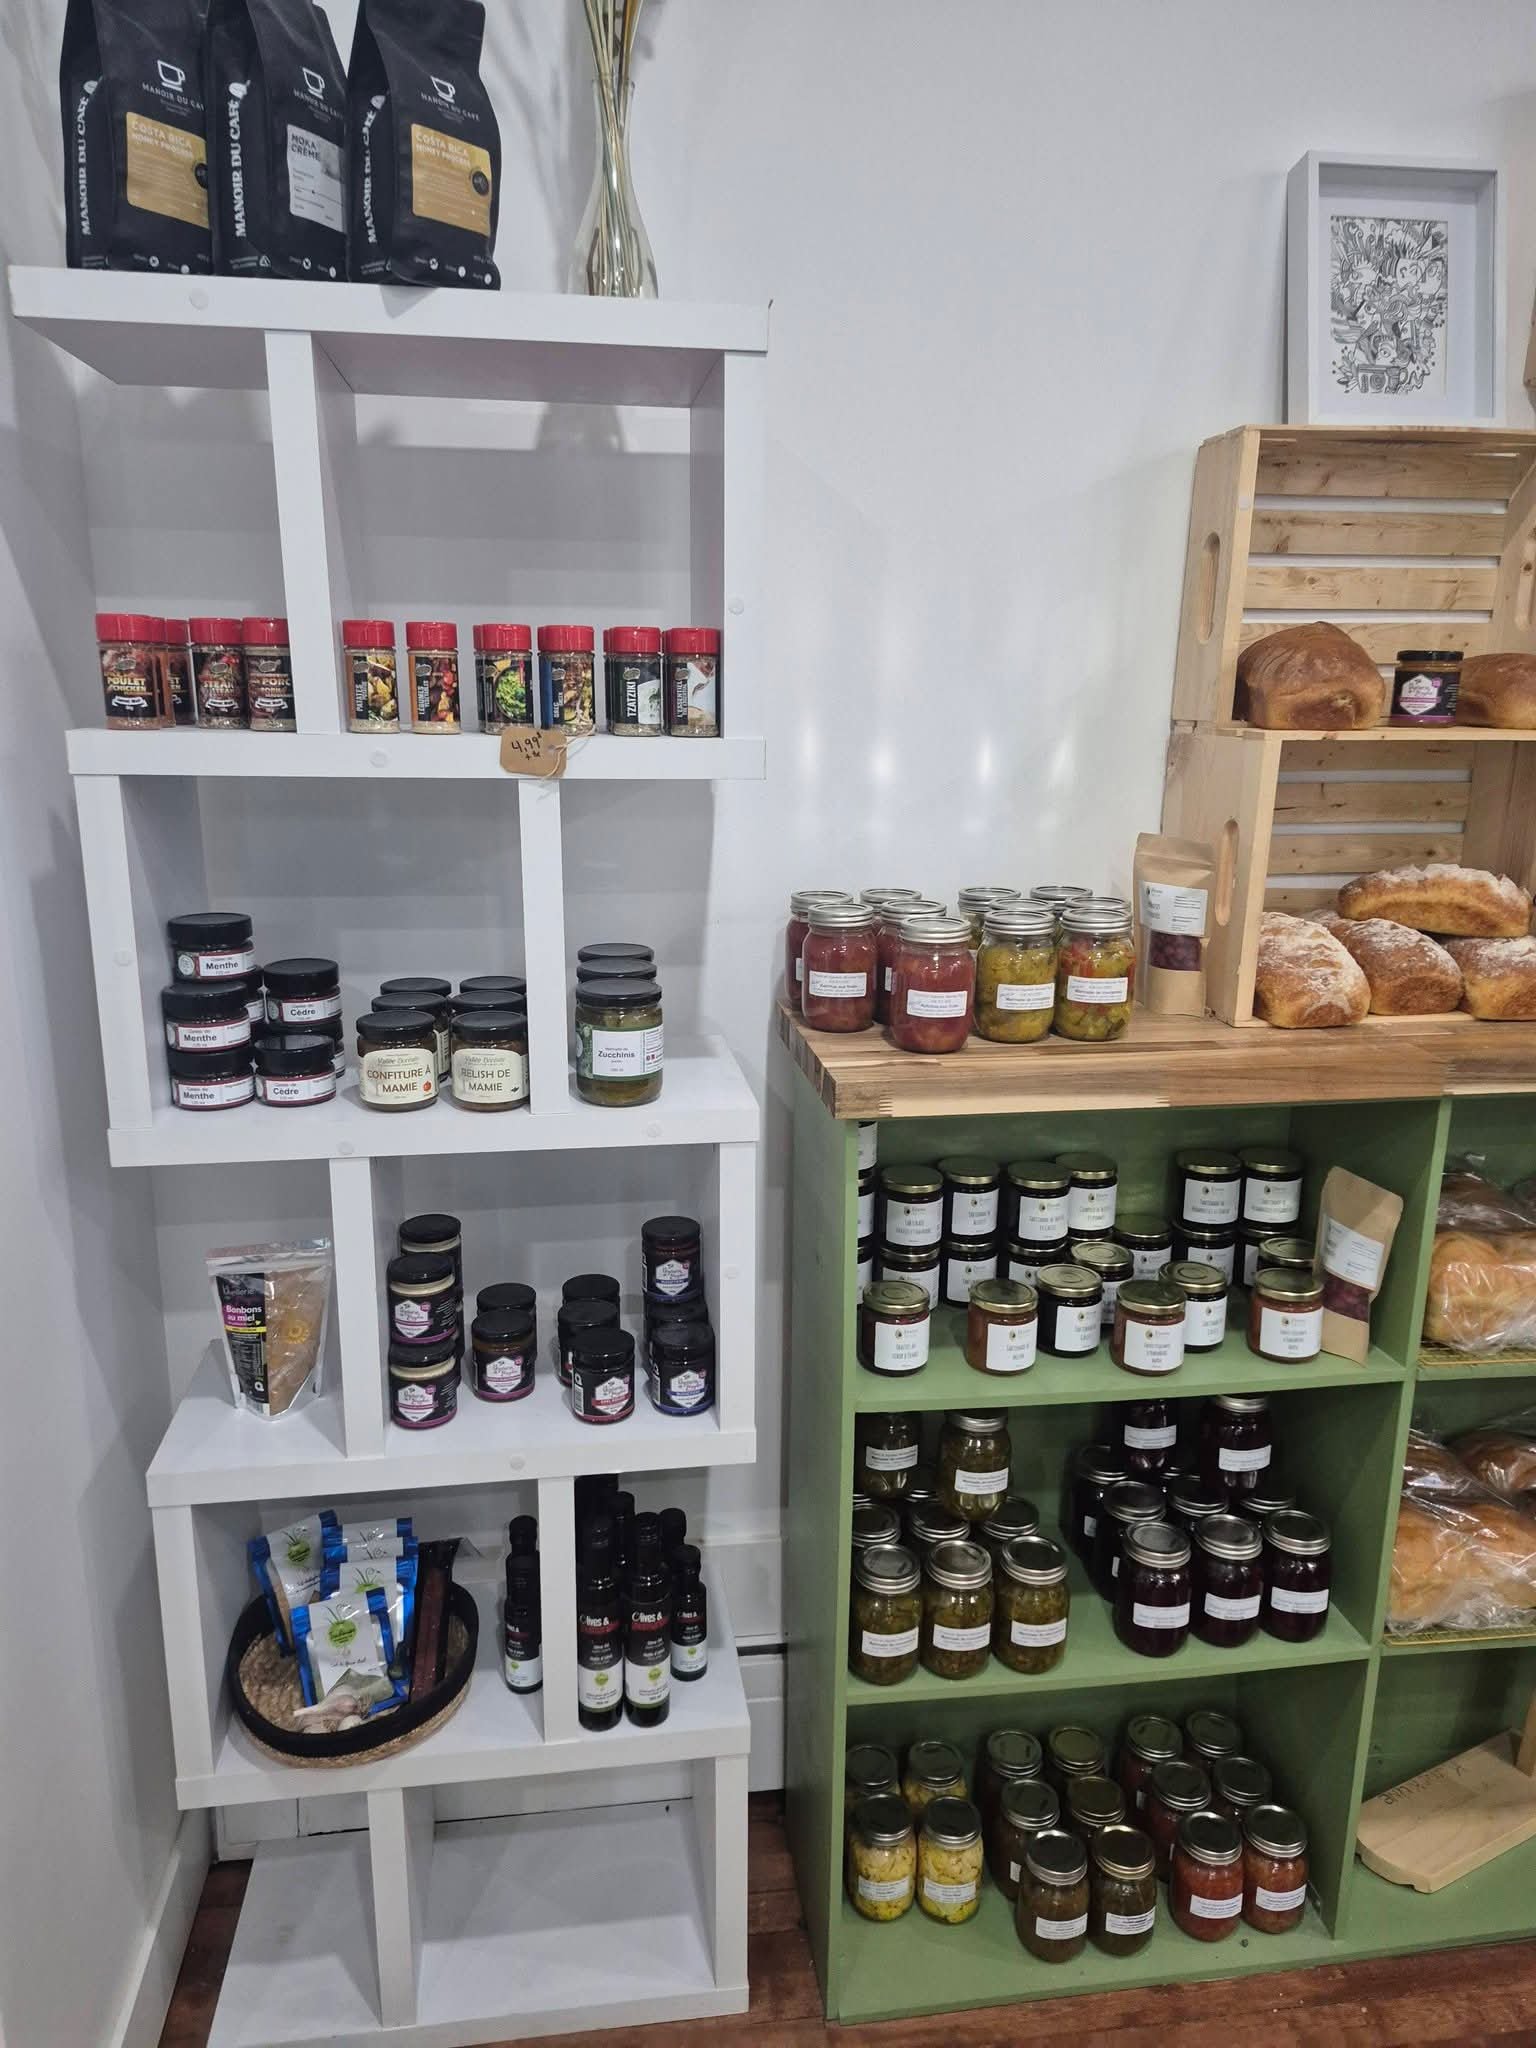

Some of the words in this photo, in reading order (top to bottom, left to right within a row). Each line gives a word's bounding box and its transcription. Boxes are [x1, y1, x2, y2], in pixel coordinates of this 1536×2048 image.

[142, 82, 175, 100] MANOIR
[177, 95, 188, 105] DU
[291, 132, 317, 151] MOKA
[78, 139, 86, 163] DU
[230, 142, 242, 167] DU
[79, 168, 91, 235] MANOIR
[231, 170, 247, 237] MANOIR
[106, 677, 146, 686] POULET
[626, 681, 637, 717] TZATZIKI
[206, 962, 239, 970] Menthe
[184, 1034, 217, 1042] Menthe
[598, 1050, 635, 1058] Zucchinis
[367, 1068, 423, 1080] CONFITURE
[461, 1068, 494, 1079] RELISH
[497, 1068, 511, 1078] DE
[382, 1082, 418, 1093] MAMIE
[468, 1082, 503, 1092] MAMIE
[183, 1091, 215, 1100] Menthe
[226, 1304, 262, 1314] Bonbons
[237, 1313, 255, 1321] miel
[580, 1614, 602, 1627] Olives
[603, 1617, 610, 1626] &
[631, 1612, 656, 1623] Olives
[657, 1611, 663, 1621] &
